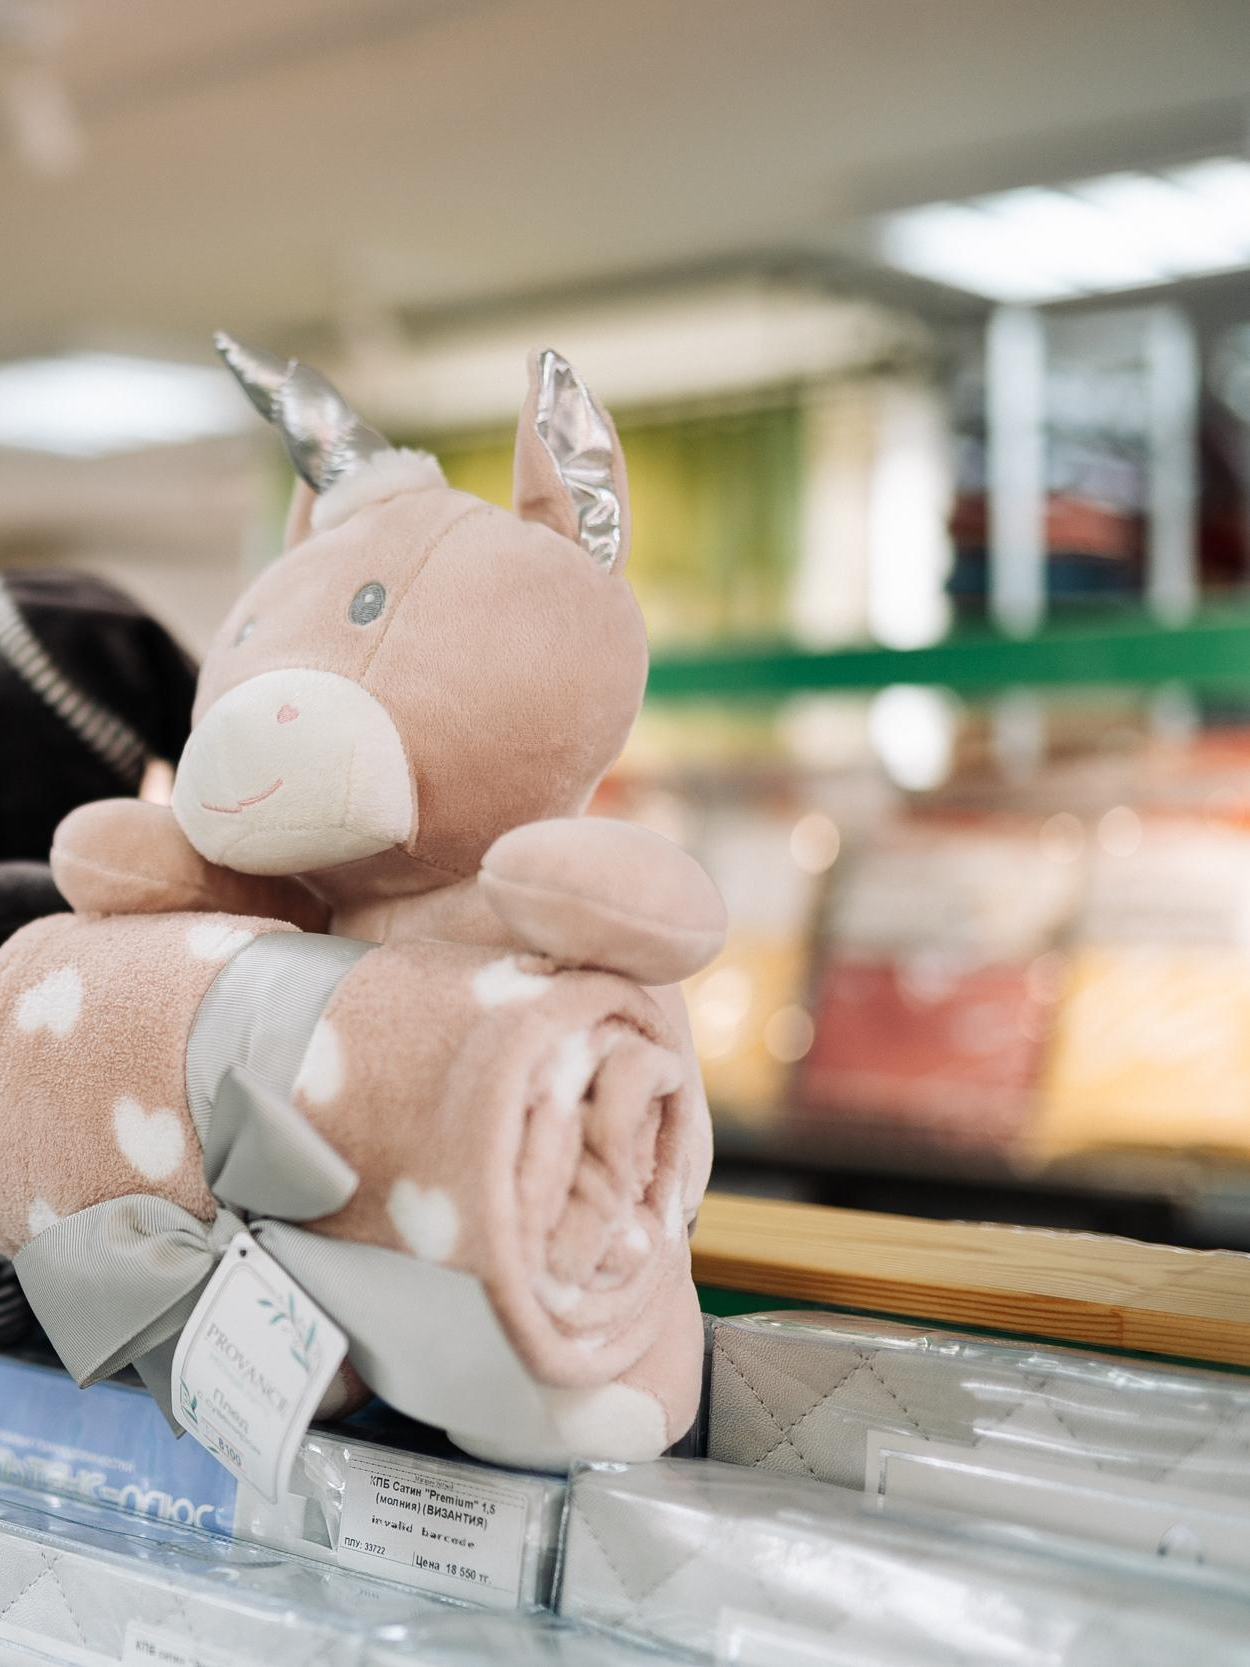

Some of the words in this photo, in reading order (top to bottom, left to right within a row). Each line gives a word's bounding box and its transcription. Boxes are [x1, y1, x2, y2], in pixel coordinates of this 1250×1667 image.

[205, 1323, 288, 1414] PROVANCE
[370, 1475, 390, 1490] КПБ
[393, 1480, 422, 1498] Сатин
[425, 1487, 479, 1511] "Premium"
[482, 1502, 496, 1515] 1,5
[344, 1536, 362, 1551] ПЛУ:
[364, 1541, 386, 1556] 33722
[371, 1514, 413, 1534] invalid
[421, 1526, 476, 1549] barcode
[415, 1553, 440, 1572] Цена
